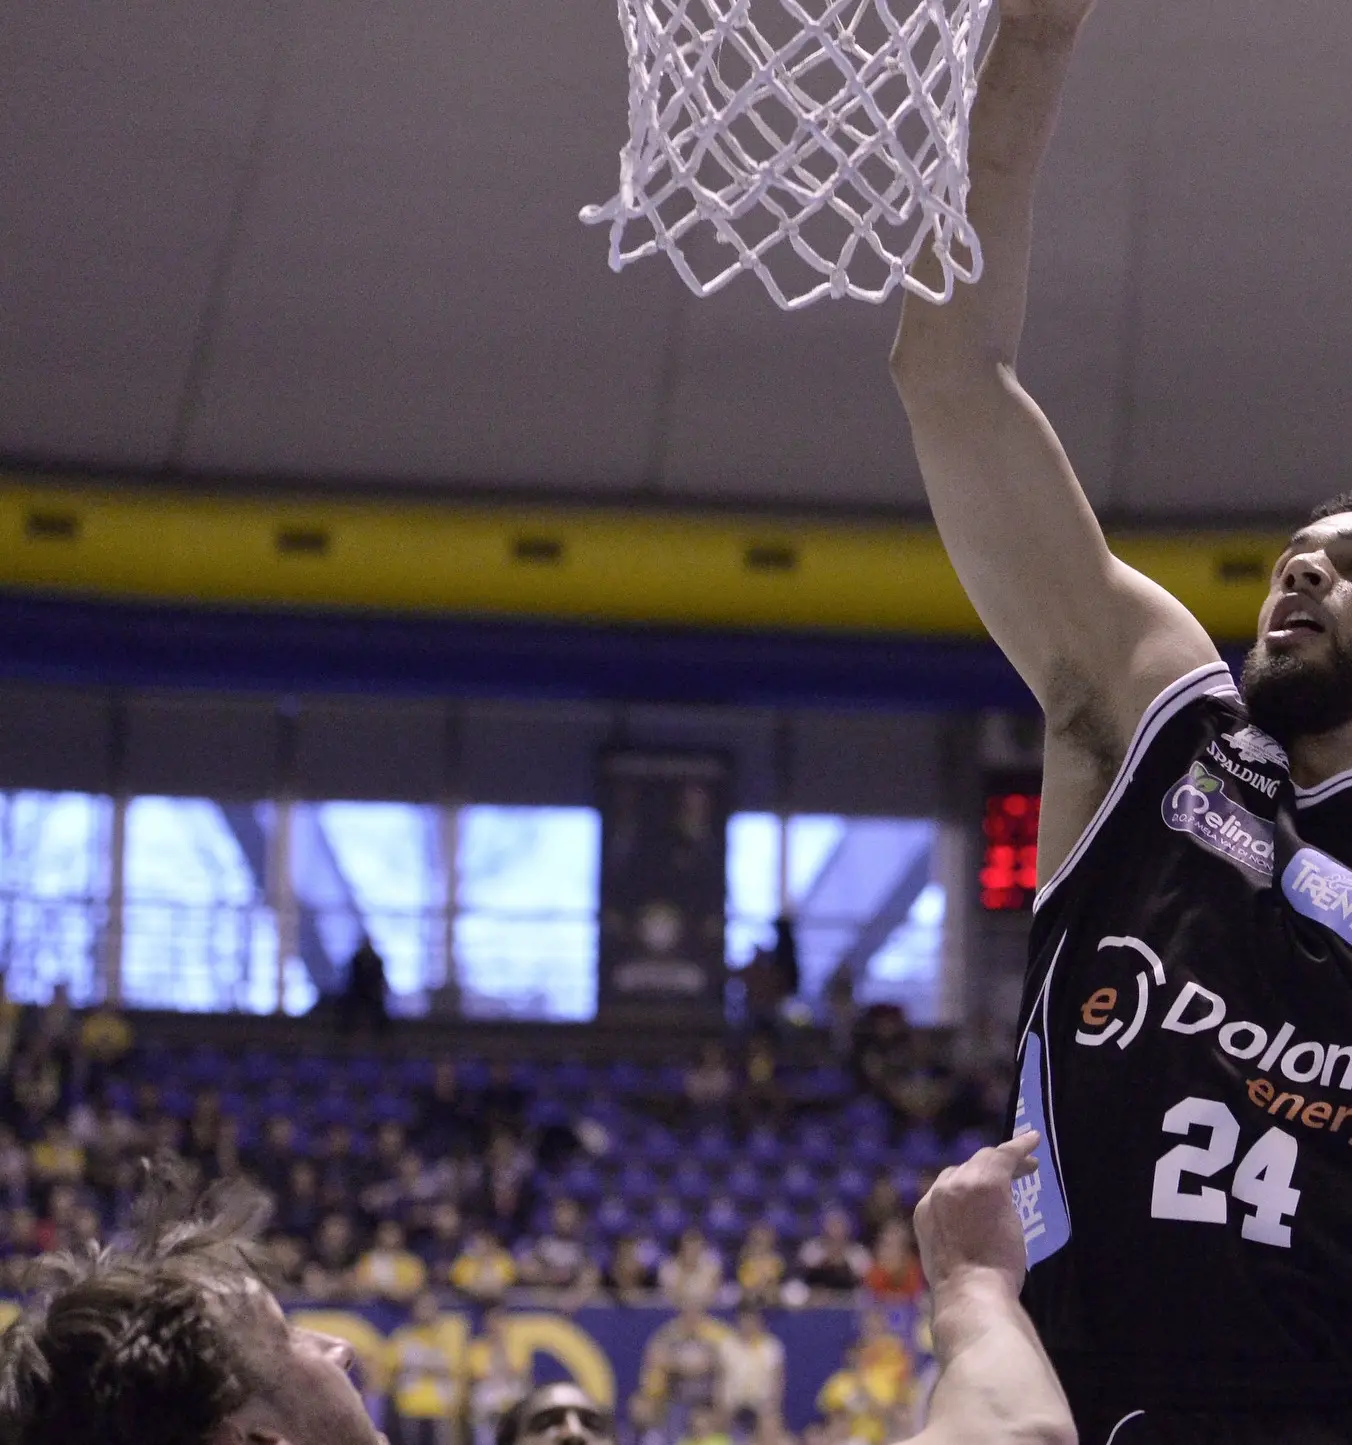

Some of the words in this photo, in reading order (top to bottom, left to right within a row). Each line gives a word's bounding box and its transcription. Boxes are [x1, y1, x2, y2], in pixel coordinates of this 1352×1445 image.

[1206, 740, 1281, 799] SPALDING
[1172, 784, 1275, 860] Melind
[1151, 1096, 1301, 1248] 24
